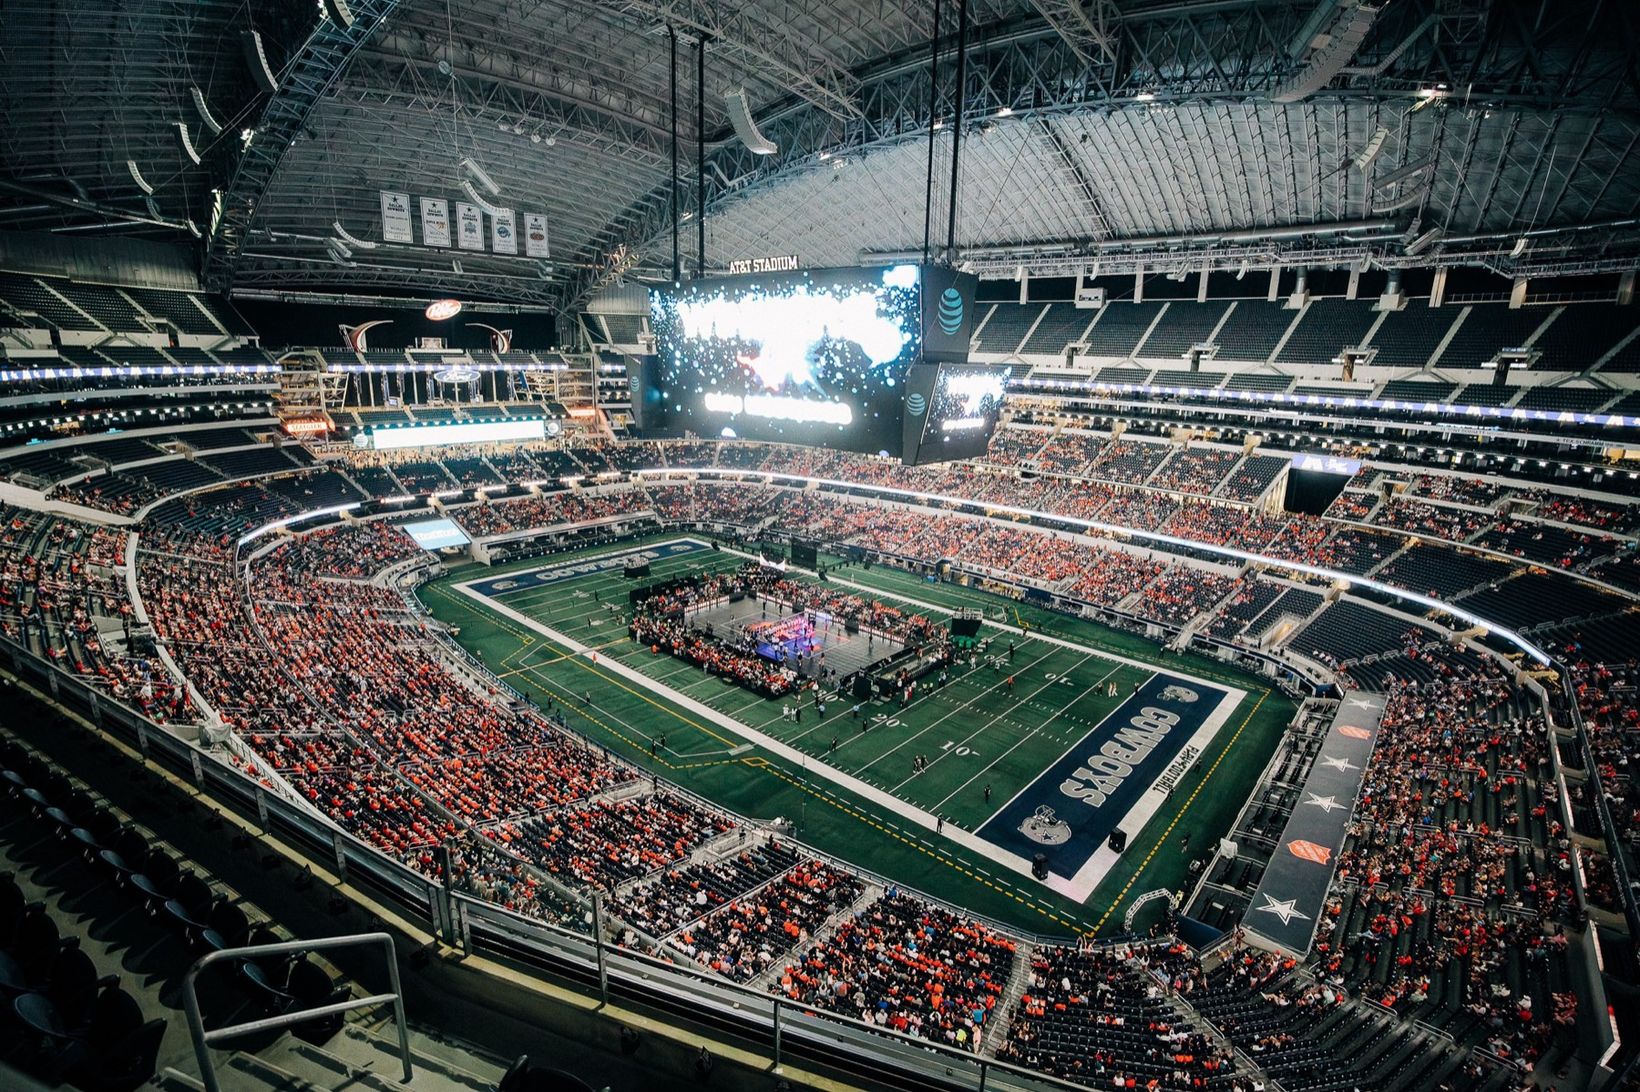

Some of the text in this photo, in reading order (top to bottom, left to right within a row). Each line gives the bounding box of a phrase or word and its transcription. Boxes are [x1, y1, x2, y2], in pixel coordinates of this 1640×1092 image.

[730, 256, 798, 274] AT&T STADIUM
[870, 713, 900, 727] 20
[940, 740, 970, 756] 10
[1060, 706, 1181, 808] COWBOYS
